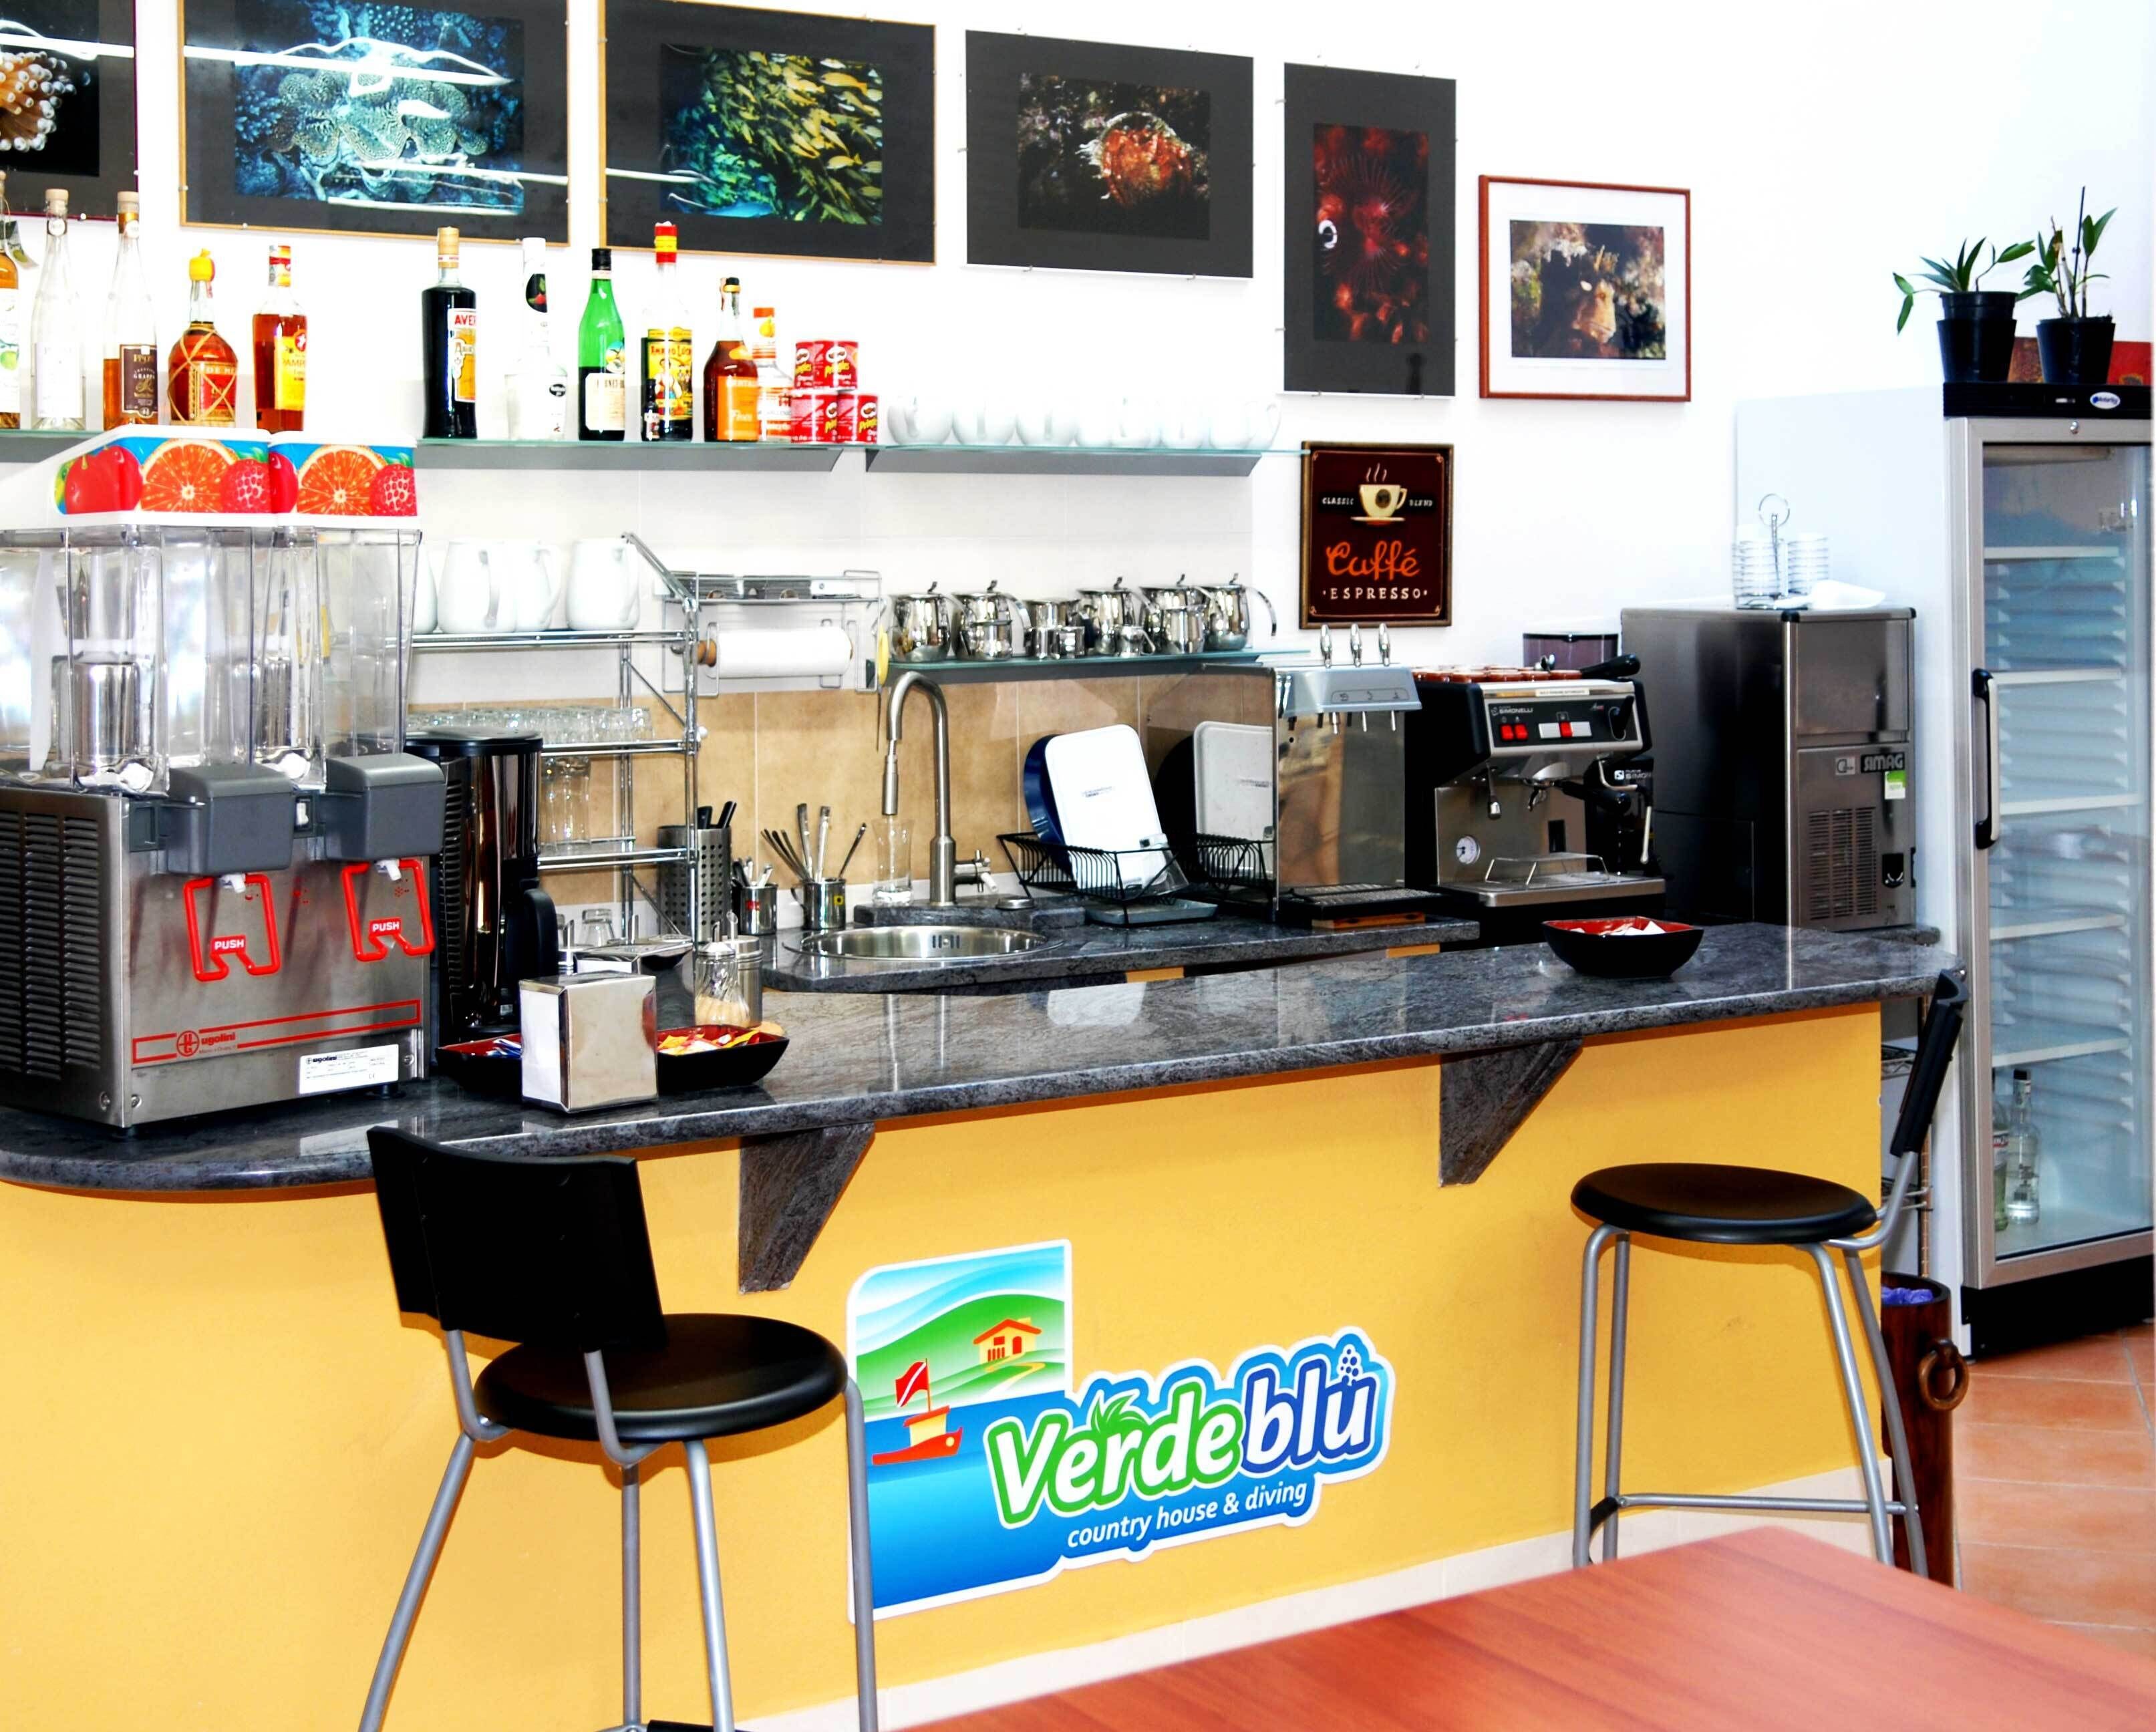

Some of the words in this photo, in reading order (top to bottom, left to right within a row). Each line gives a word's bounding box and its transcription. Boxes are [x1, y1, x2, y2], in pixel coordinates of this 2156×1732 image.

[1322, 496, 1354, 506] CLASSIC
[1409, 499, 1433, 507] BLEND
[1330, 587, 1421, 600] ESPRESSO
[1863, 753, 1904, 772] SIMAG
[371, 921, 400, 932] PUSH
[214, 939, 245, 950] PUSH
[201, 1031, 236, 1046] ugolini
[1067, 1516, 1153, 1548] country
[1155, 1502, 1217, 1531] house
[1223, 1493, 1239, 1514] &
[1244, 1479, 1309, 1511] diving
